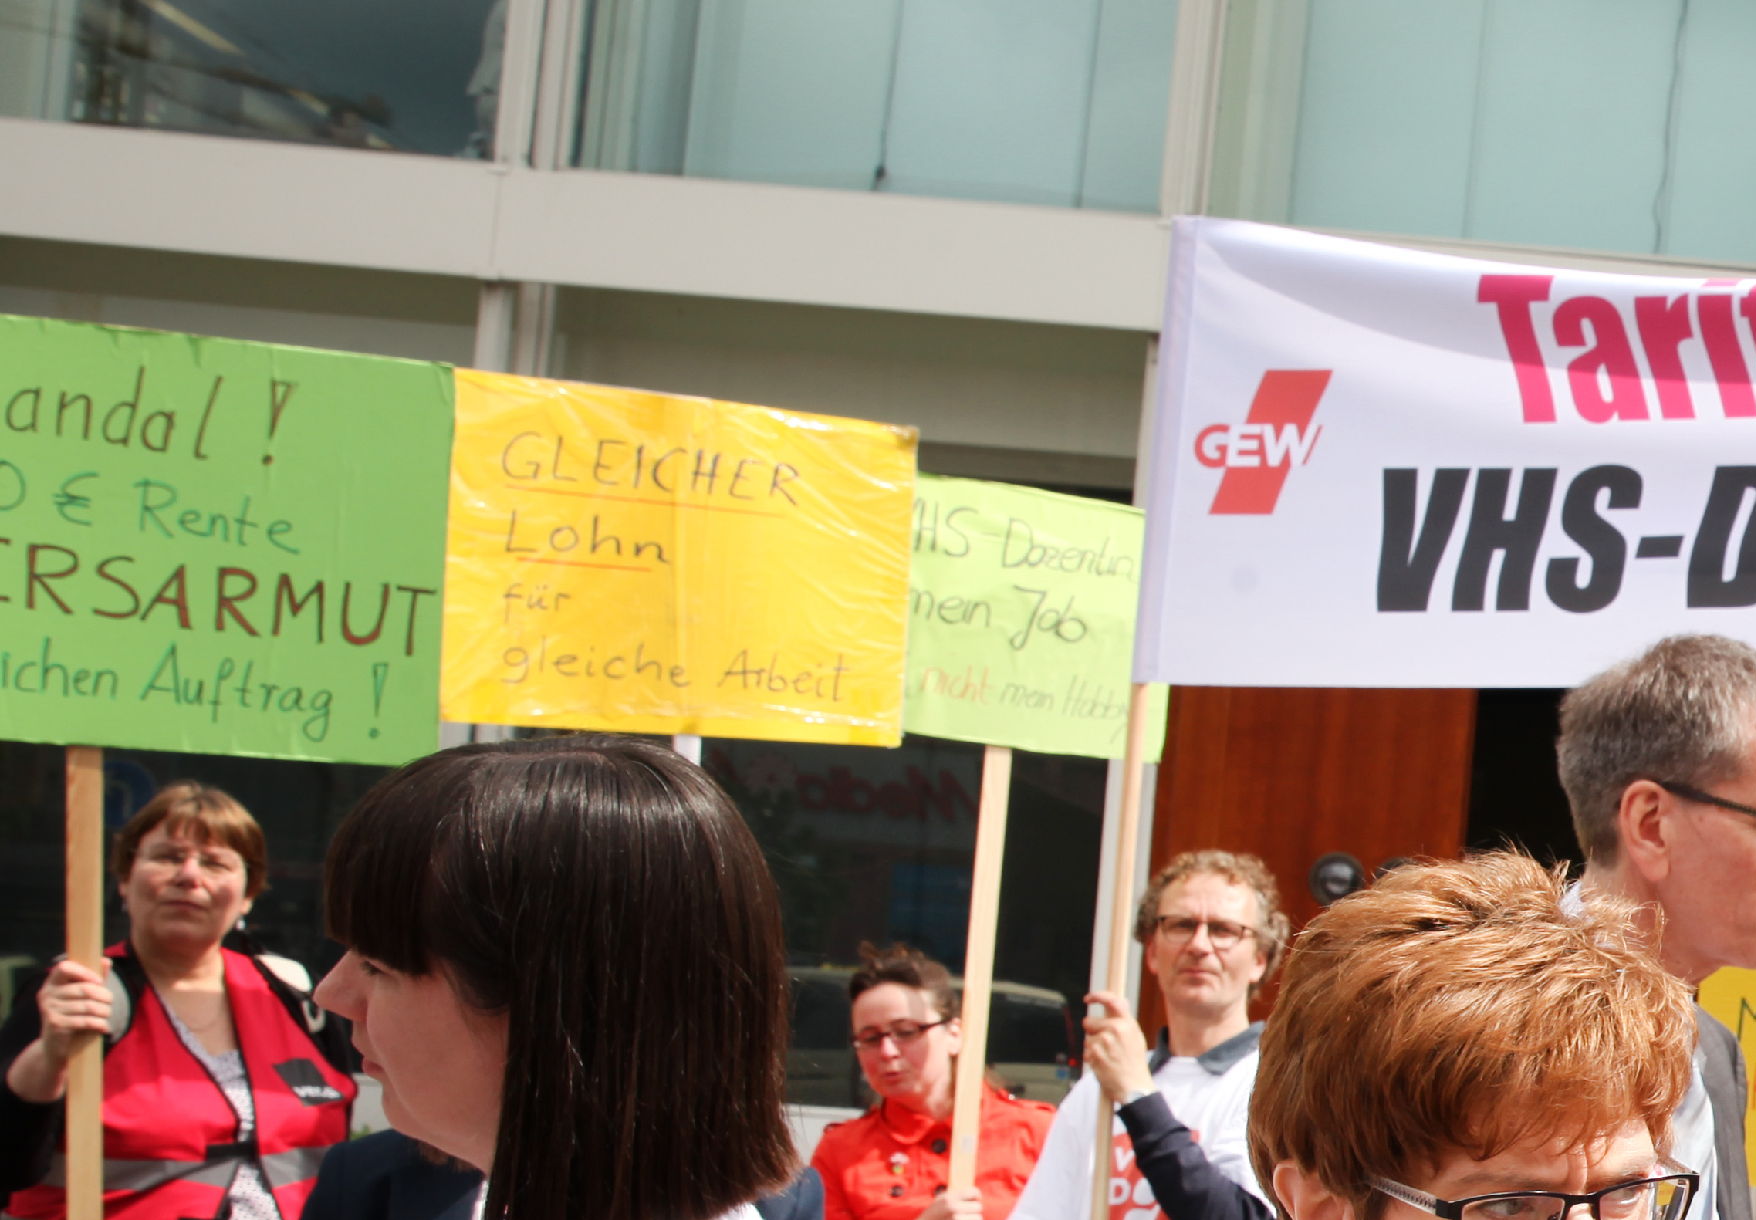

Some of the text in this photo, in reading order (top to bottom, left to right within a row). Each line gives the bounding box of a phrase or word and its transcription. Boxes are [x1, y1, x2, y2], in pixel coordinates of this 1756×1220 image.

[501, 430, 800, 507] GLEICHER
[1194, 422, 1323, 469] GEW
[132, 477, 301, 556] Rente
[504, 508, 669, 564] Lohn
[0, 536, 438, 656] RSARMUT
[500, 582, 572, 624] für
[1009, 584, 1088, 651] Job
[140, 642, 334, 742] Auftrag
[501, 635, 850, 704] gleiche Arbeit
